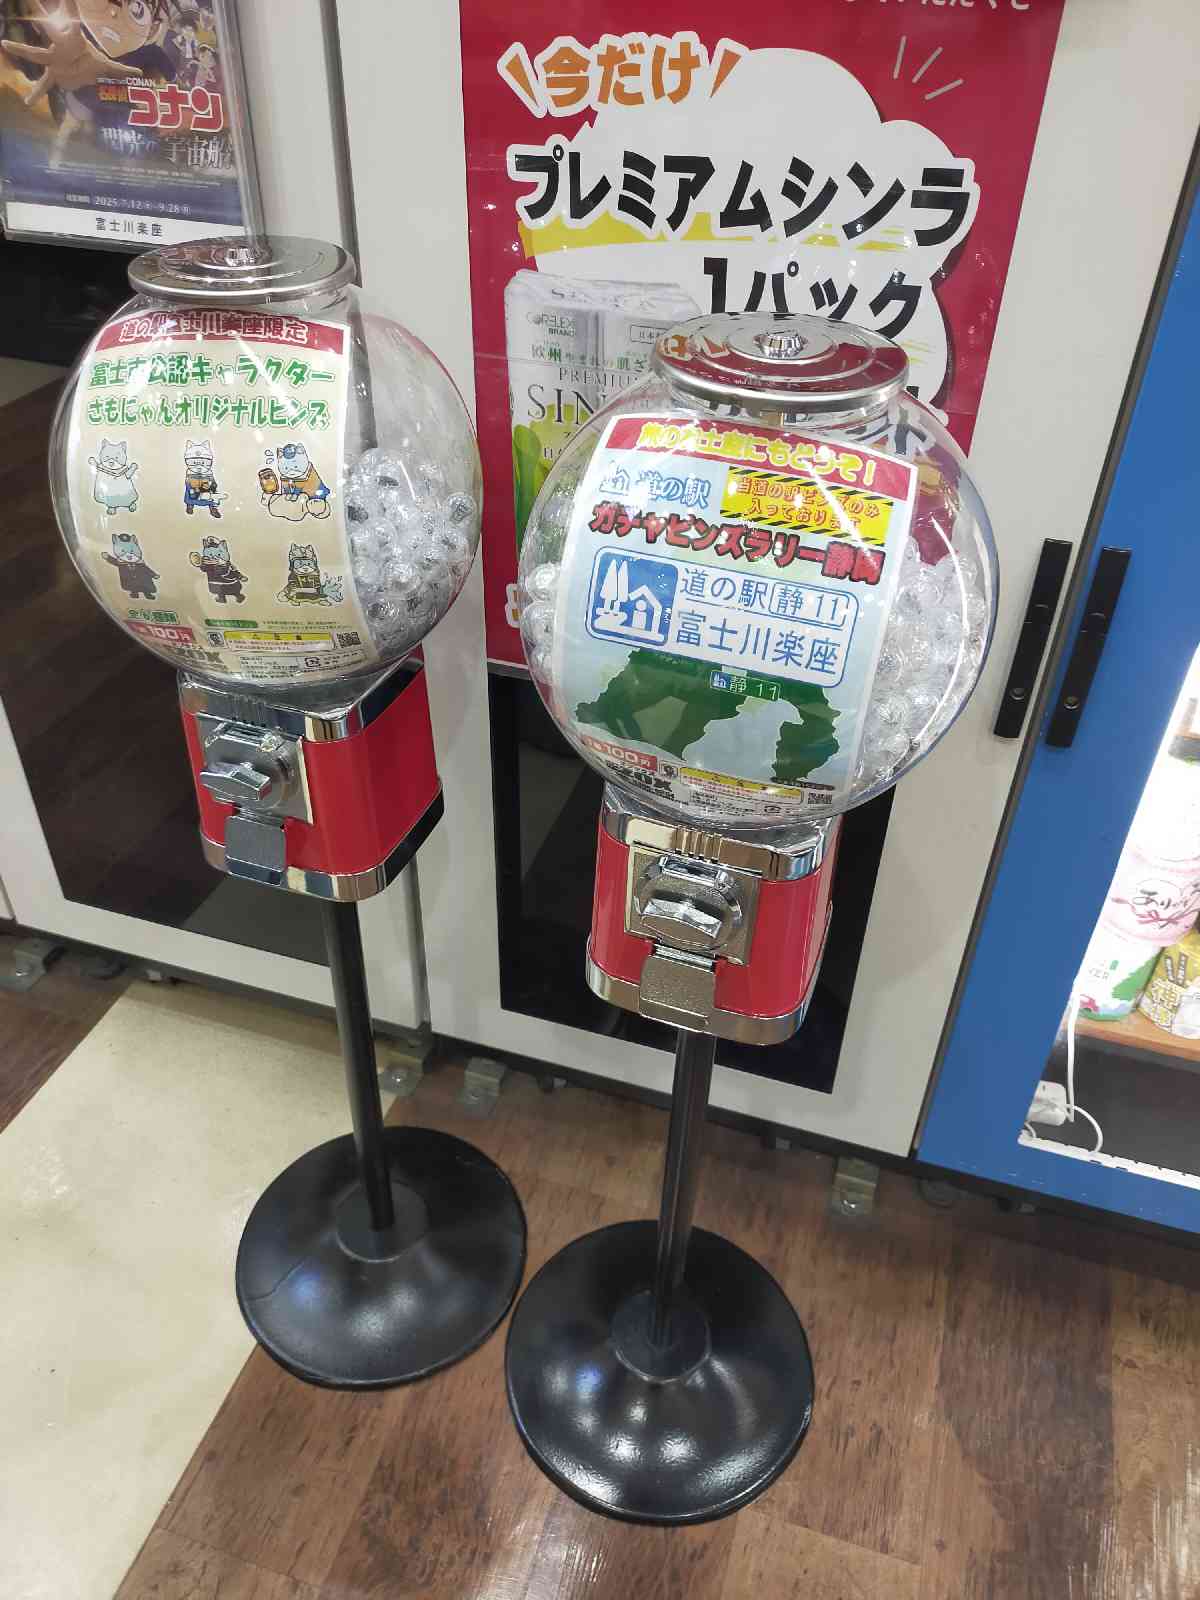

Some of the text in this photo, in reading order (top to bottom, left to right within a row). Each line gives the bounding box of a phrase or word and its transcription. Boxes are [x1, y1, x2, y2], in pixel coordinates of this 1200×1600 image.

[542, 41, 703, 108] 今だけ
[127, 84, 223, 132] コナン
[514, 143, 971, 248] プレミアムシンラ
[95, 216, 164, 237] 富士川楽座
[702, 256, 925, 340] 1パック
[558, 367, 638, 388] PREMIU
[679, 567, 770, 609] 道の駅
[675, 608, 841, 676] 富士川楽座
